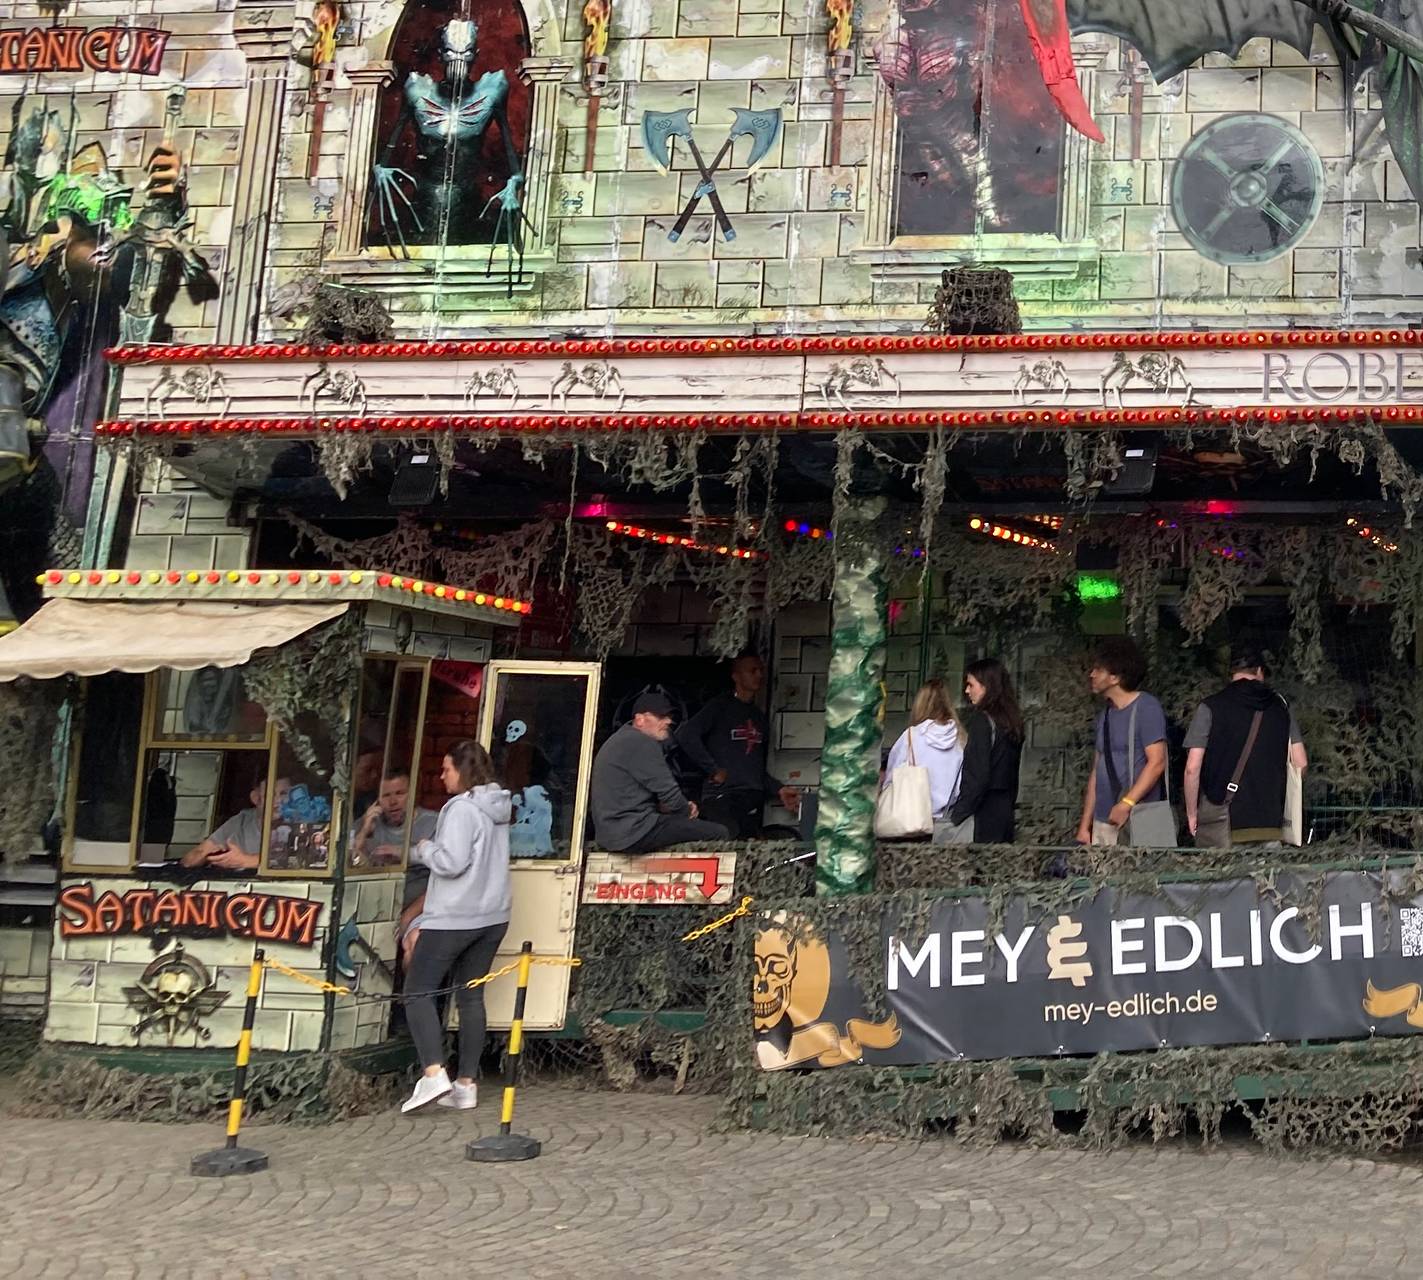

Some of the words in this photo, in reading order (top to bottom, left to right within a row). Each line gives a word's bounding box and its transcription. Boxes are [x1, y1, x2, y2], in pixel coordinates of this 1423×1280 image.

[59, 882, 323, 947] SATANICUM
[595, 882, 687, 900] EINGANG
[888, 926, 1036, 990] MEY
[1111, 902, 1375, 975] EDLICH
[1044, 989, 1217, 1025] mey-edlich.de
